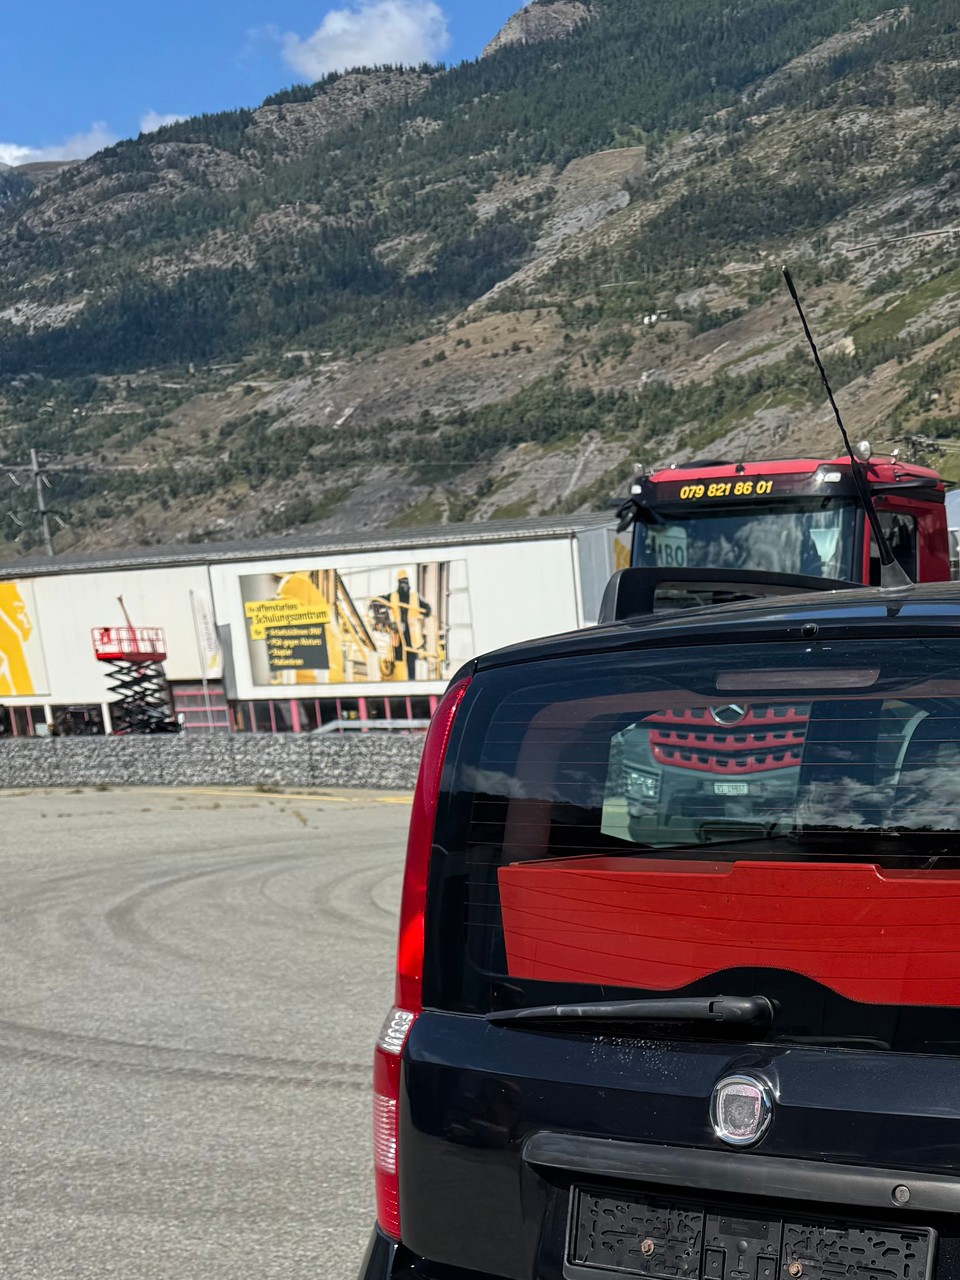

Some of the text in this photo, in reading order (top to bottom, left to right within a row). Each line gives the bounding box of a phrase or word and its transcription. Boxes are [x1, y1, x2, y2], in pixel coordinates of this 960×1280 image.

[680, 480, 773, 499] 079 821 86 01
